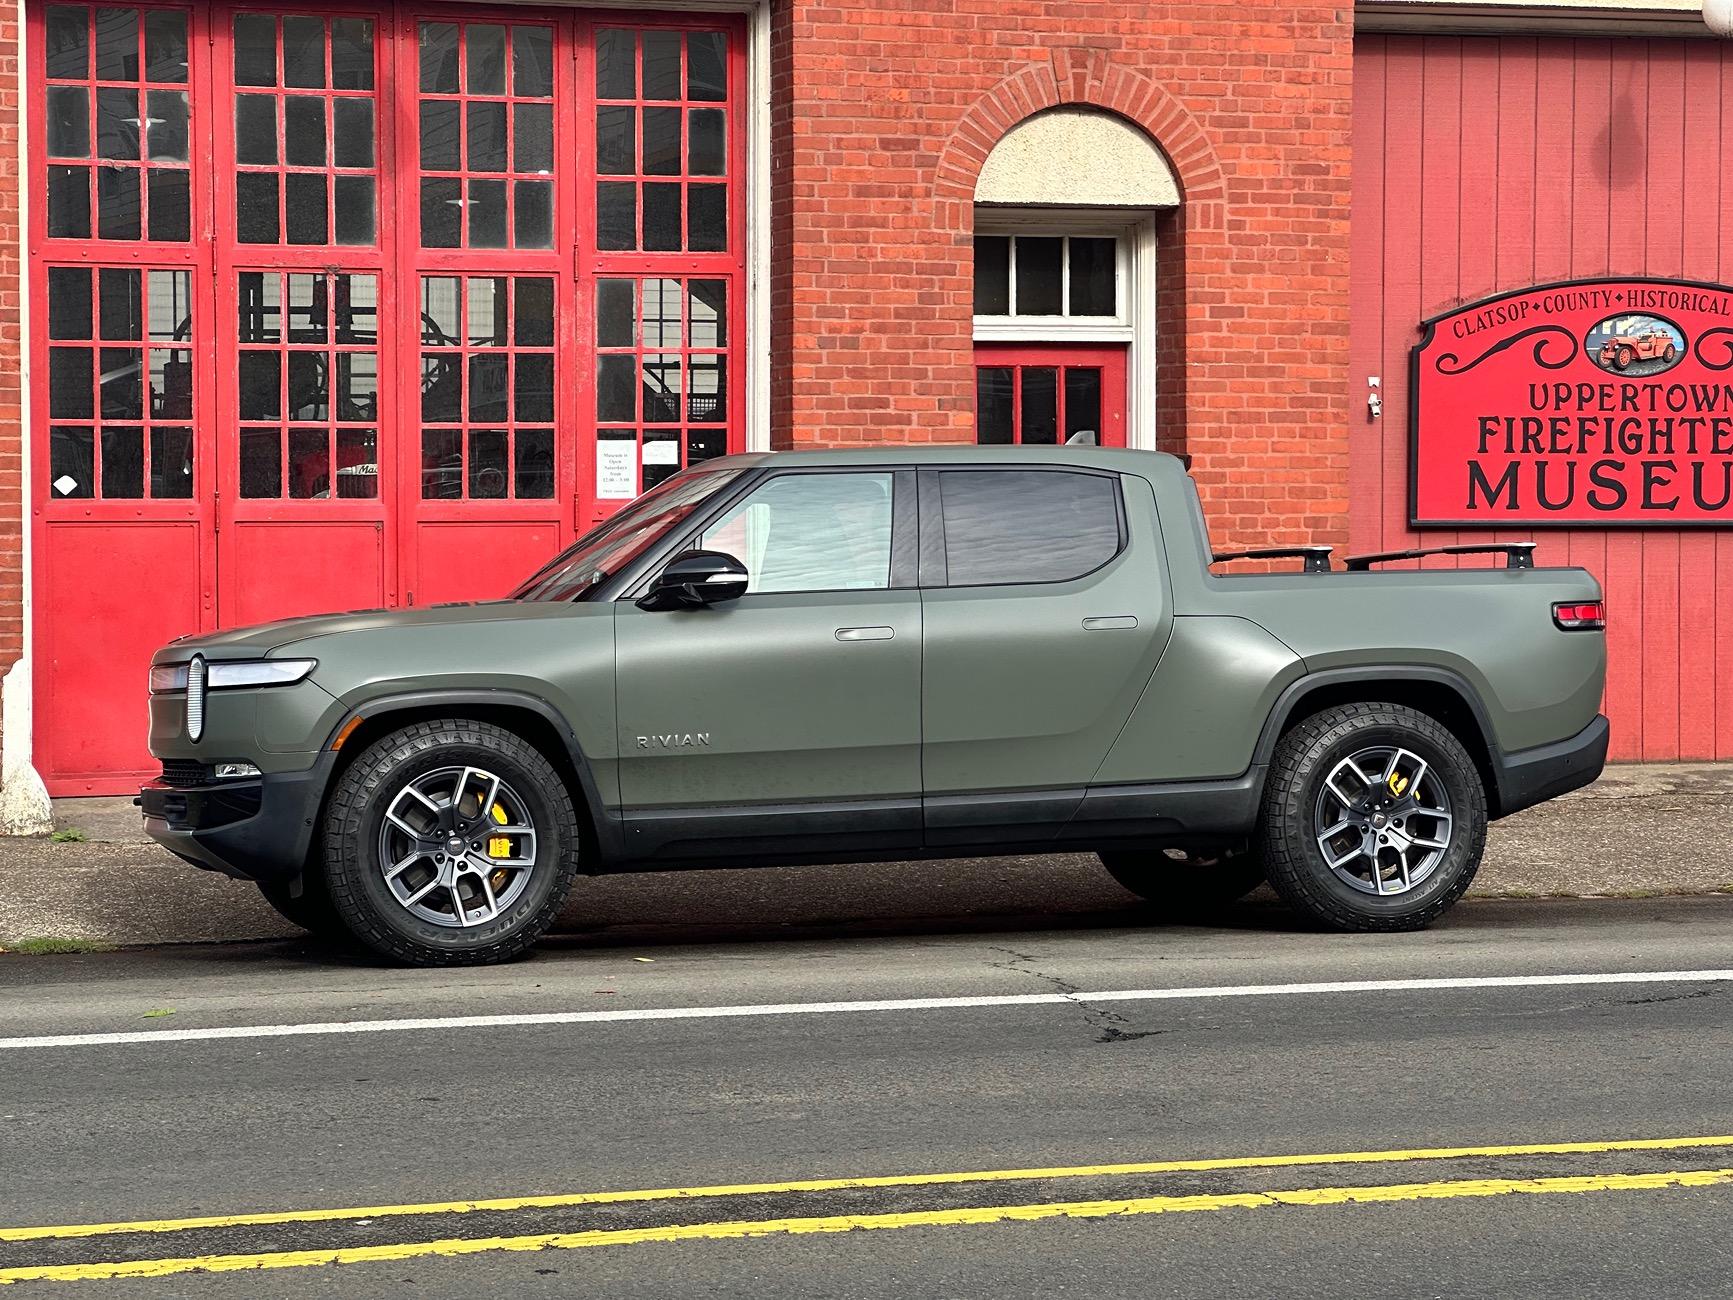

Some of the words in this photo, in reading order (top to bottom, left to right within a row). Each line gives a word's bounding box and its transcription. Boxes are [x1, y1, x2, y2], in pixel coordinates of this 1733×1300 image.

[1453, 300, 1529, 339] CLATSOP
[1543, 290, 1613, 314] COUNTY
[1627, 289, 1731, 316] HISTORICAL
[1477, 415, 1733, 455] FIREFIGHTE
[1466, 459, 1733, 511] MUSEU
[636, 732, 709, 749] RIVIAN
